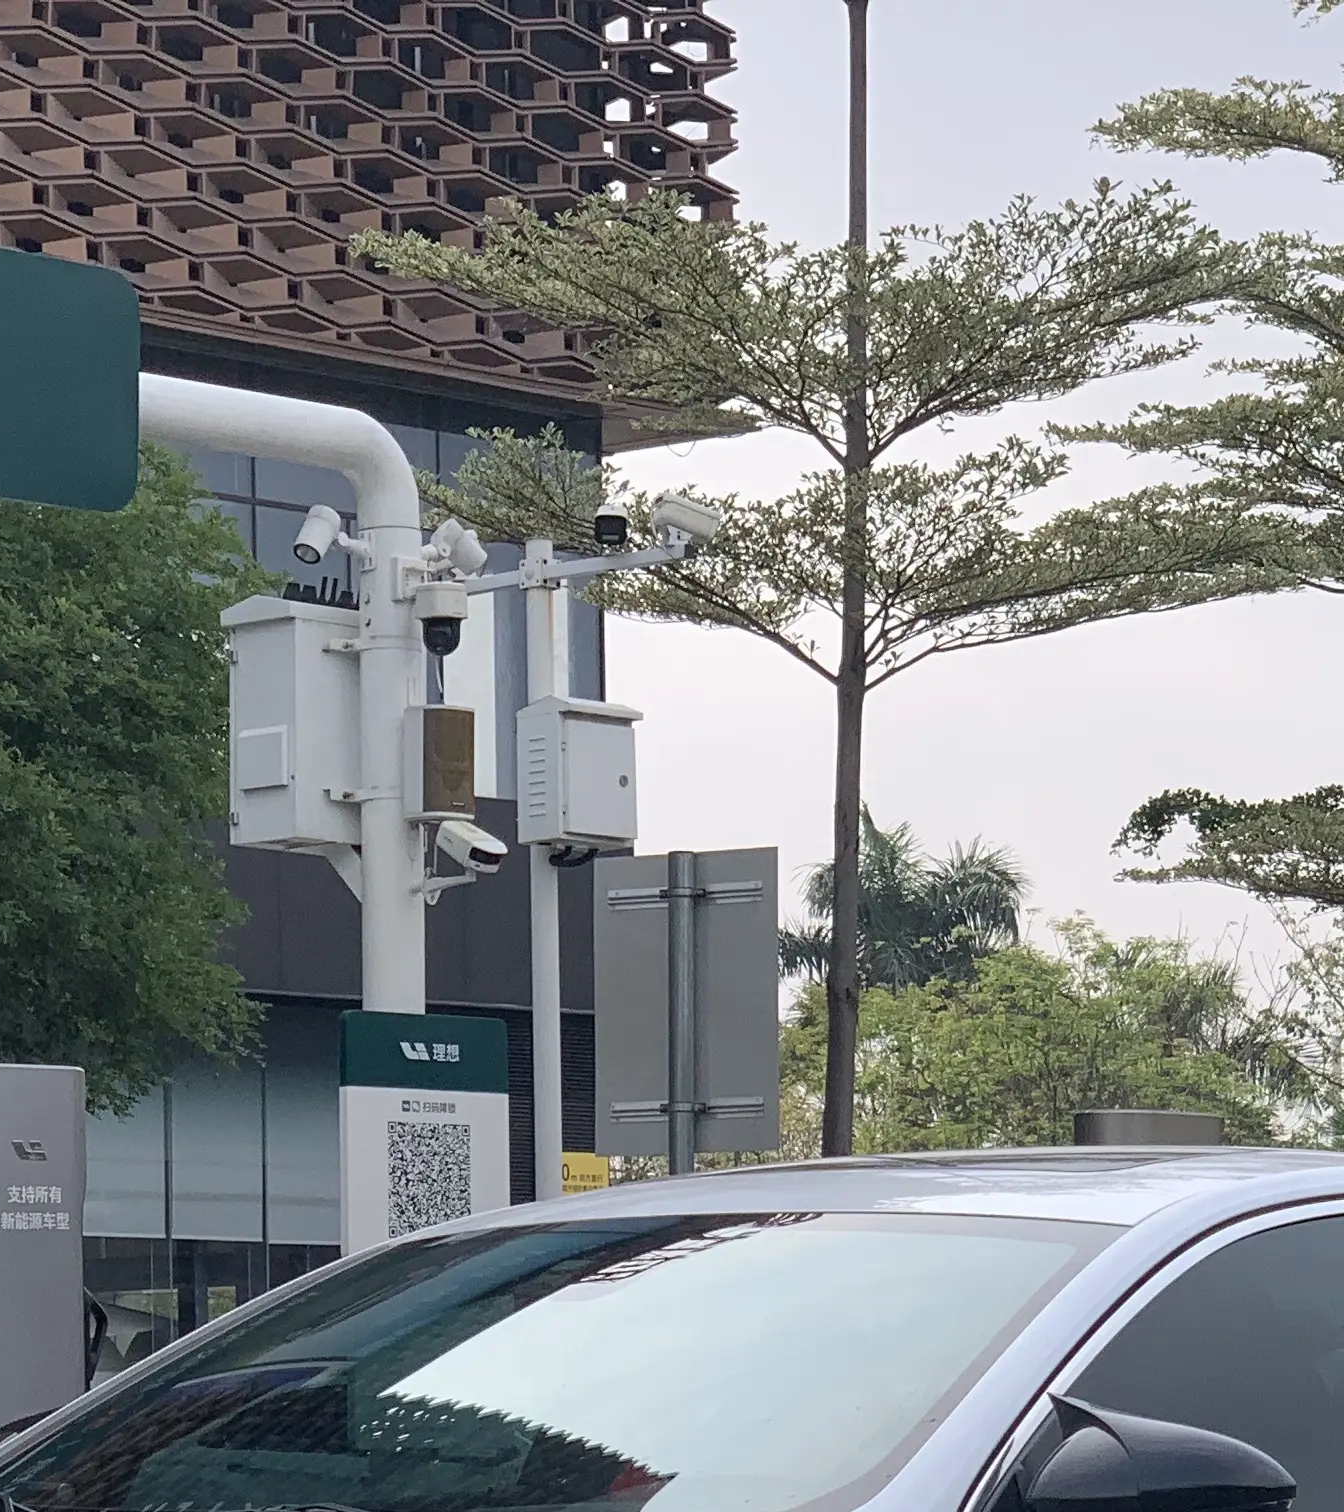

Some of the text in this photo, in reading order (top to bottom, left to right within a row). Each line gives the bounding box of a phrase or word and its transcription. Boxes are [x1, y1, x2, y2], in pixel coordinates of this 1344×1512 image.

[432, 1043, 460, 1062] 理想
[7, 1186, 62, 1204] 支持所有
[0, 1212, 70, 1230] 新能源车型
